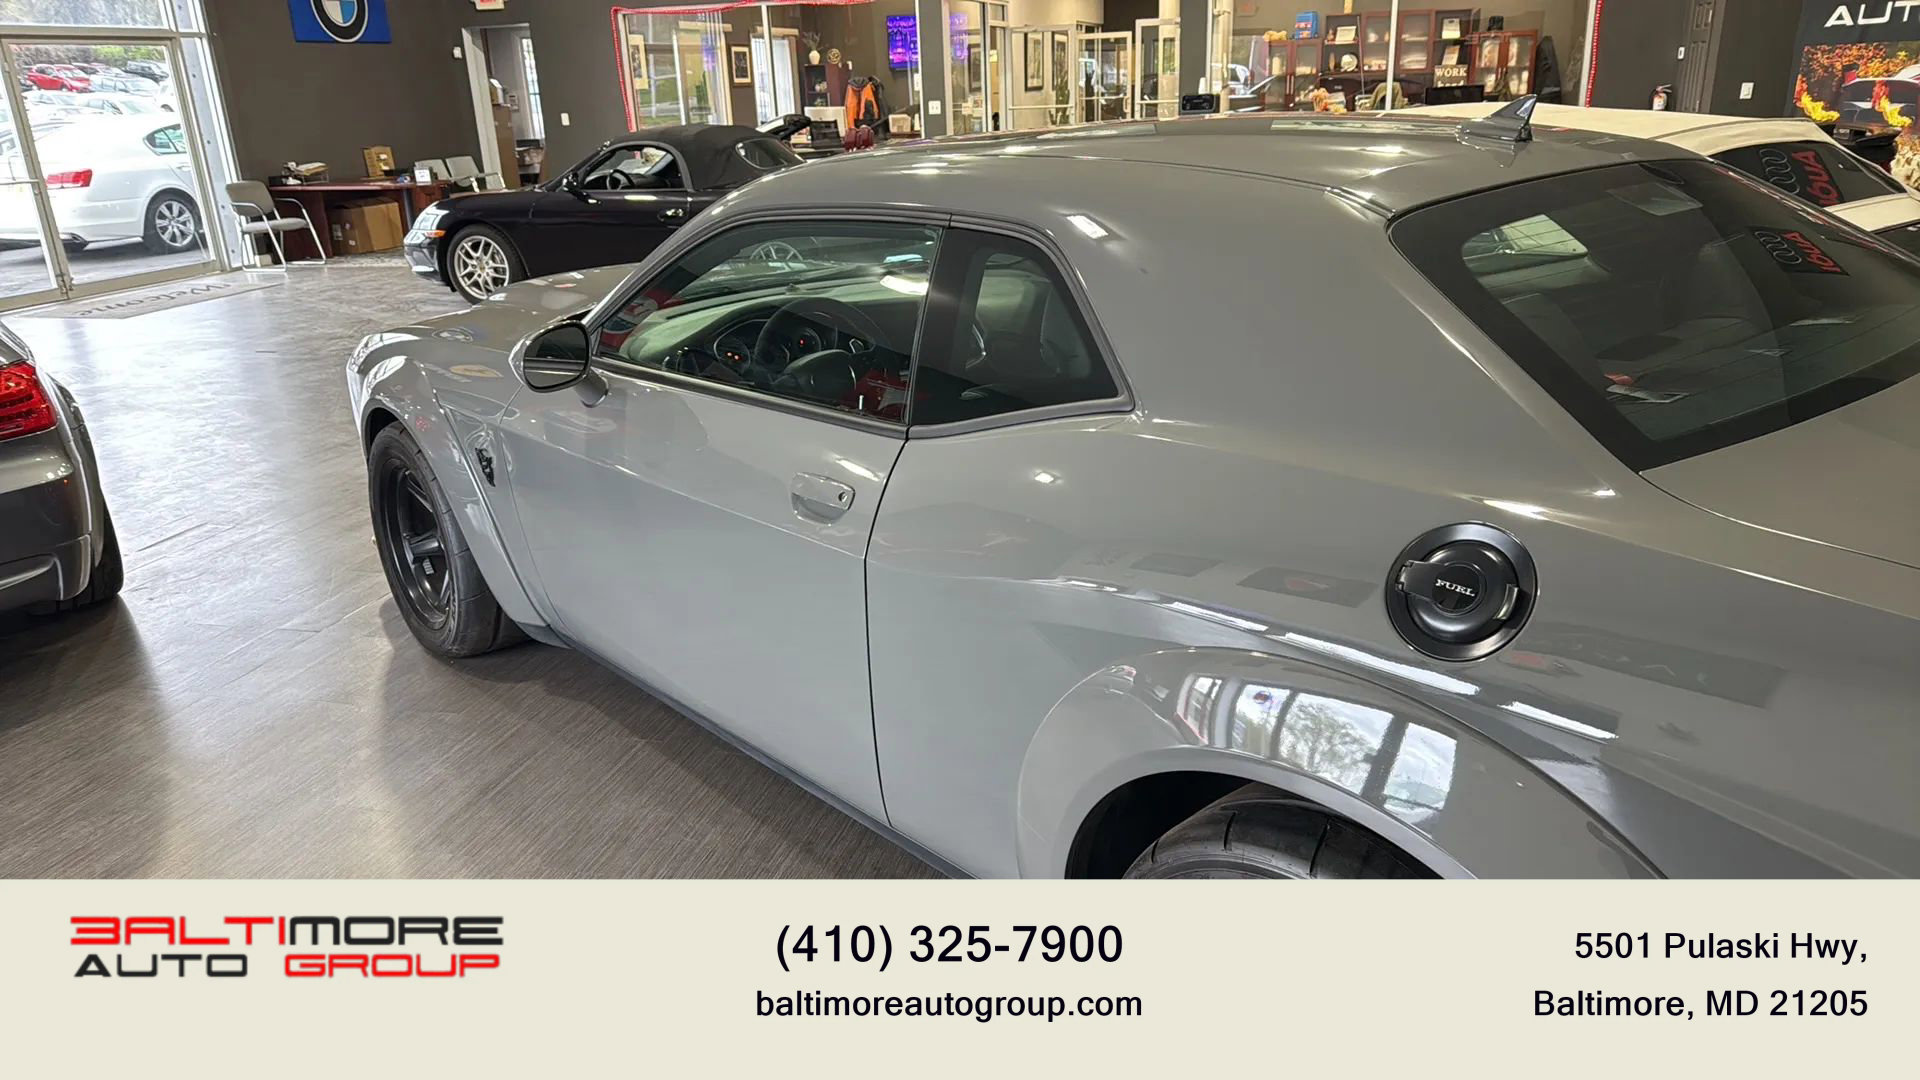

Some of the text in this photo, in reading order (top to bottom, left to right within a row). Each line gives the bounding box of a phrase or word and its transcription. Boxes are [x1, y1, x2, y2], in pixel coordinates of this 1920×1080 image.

[1823, 0, 1920, 28] AUT
[1434, 67, 1468, 77] WORK
[74, 283, 231, 316] Welcome
[1435, 578, 1476, 597] FUEL
